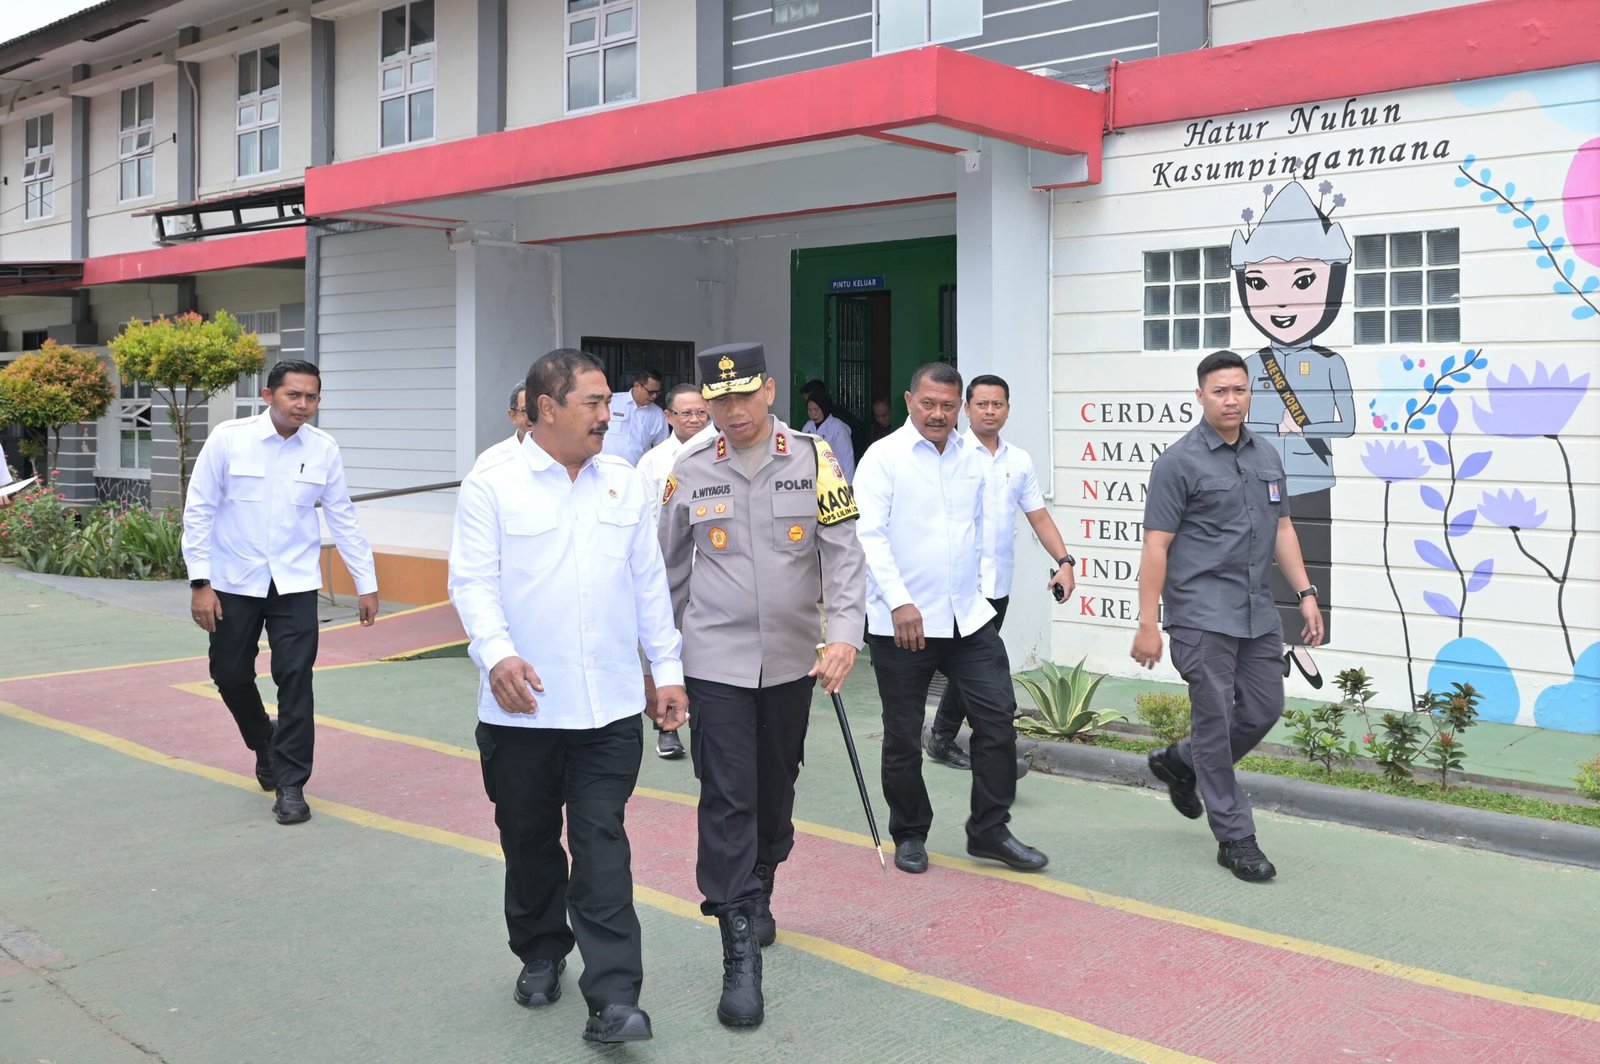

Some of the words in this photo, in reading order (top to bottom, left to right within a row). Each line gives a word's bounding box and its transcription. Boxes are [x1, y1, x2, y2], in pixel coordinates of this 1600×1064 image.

[1184, 119, 1269, 147] Hatur
[1287, 98, 1402, 134] Nuhun
[1152, 139, 1450, 187] Kasumpingannana
[832, 280, 851, 289] PINTU
[852, 278, 877, 287] KELUAR
[1080, 402, 1193, 424] CERDAS
[775, 479, 812, 491] POLRI
